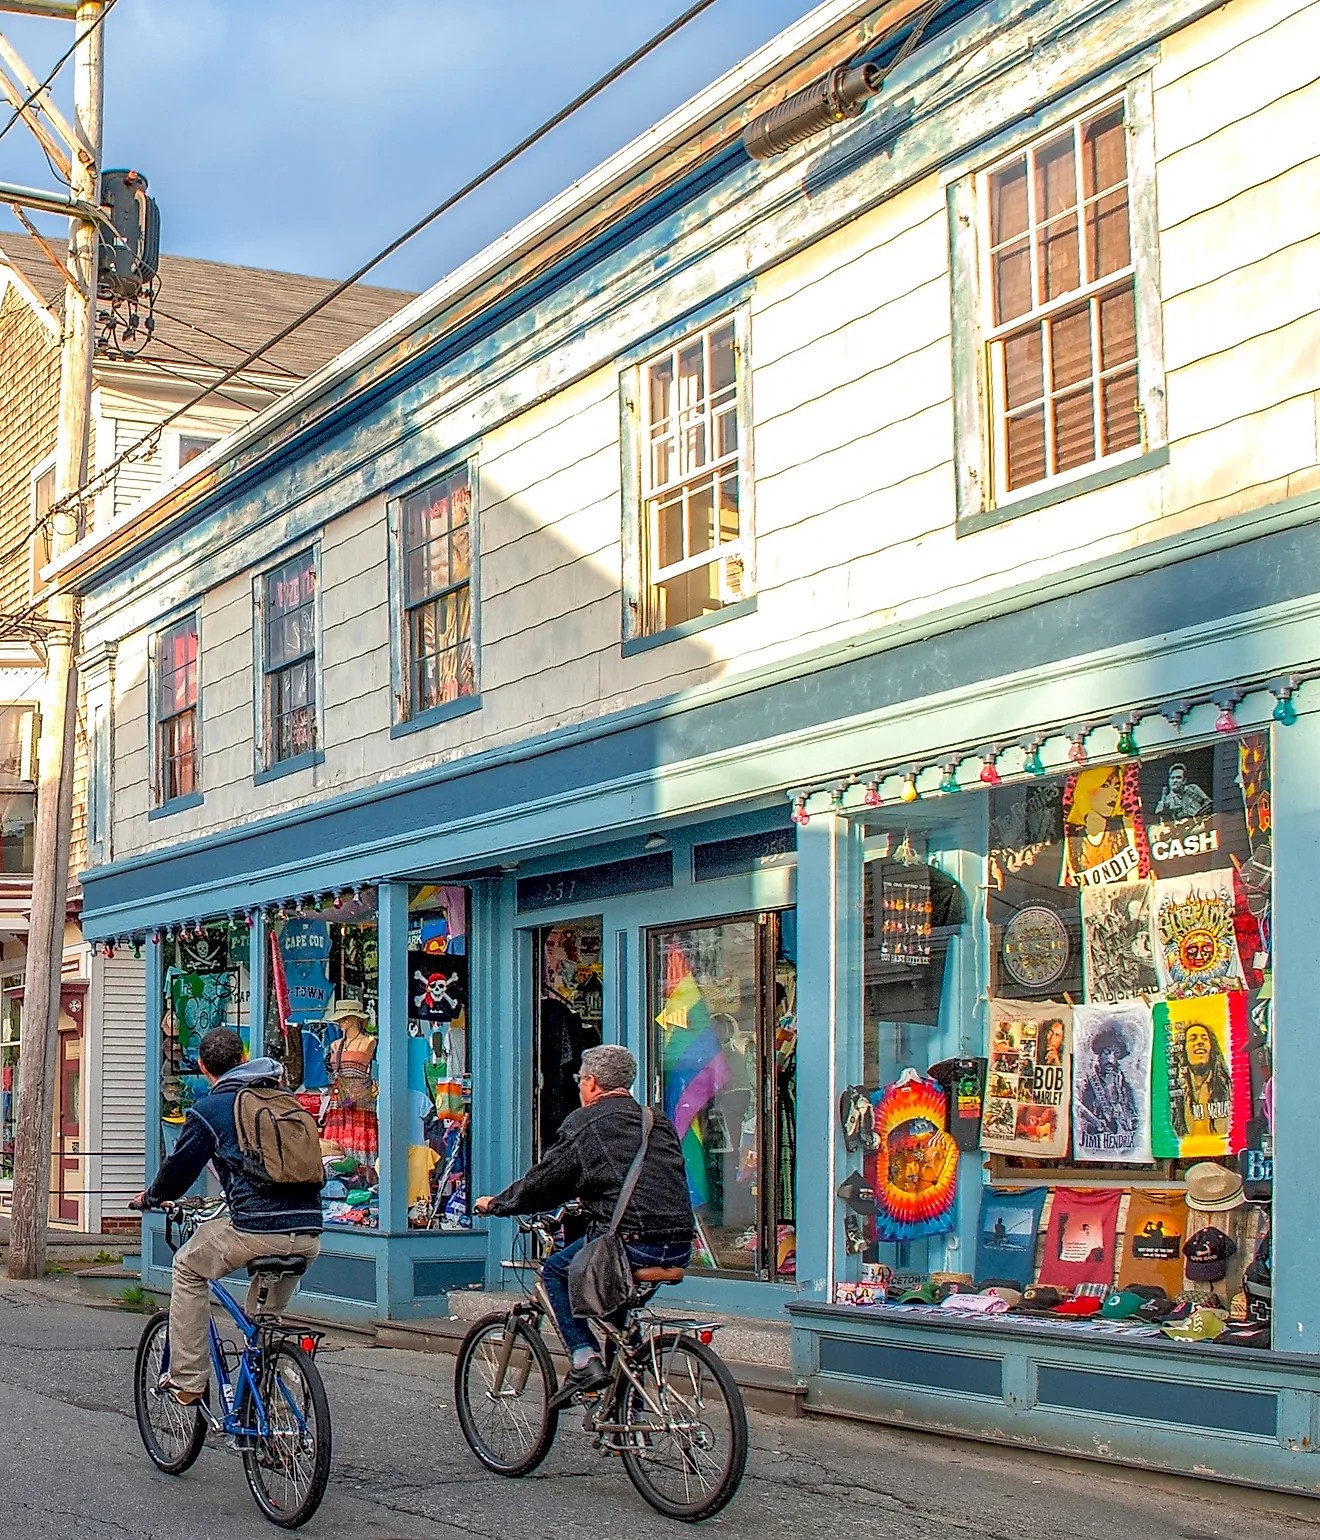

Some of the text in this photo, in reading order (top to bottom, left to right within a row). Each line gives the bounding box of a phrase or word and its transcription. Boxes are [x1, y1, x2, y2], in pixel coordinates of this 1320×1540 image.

[1152, 831, 1218, 861] CASH
[285, 935, 307, 950] CAPE
[1033, 1066, 1064, 1091] BOB
[1033, 1090, 1063, 1106] MARLEY
[1079, 1132, 1135, 1149] JIMI HENDRIX
